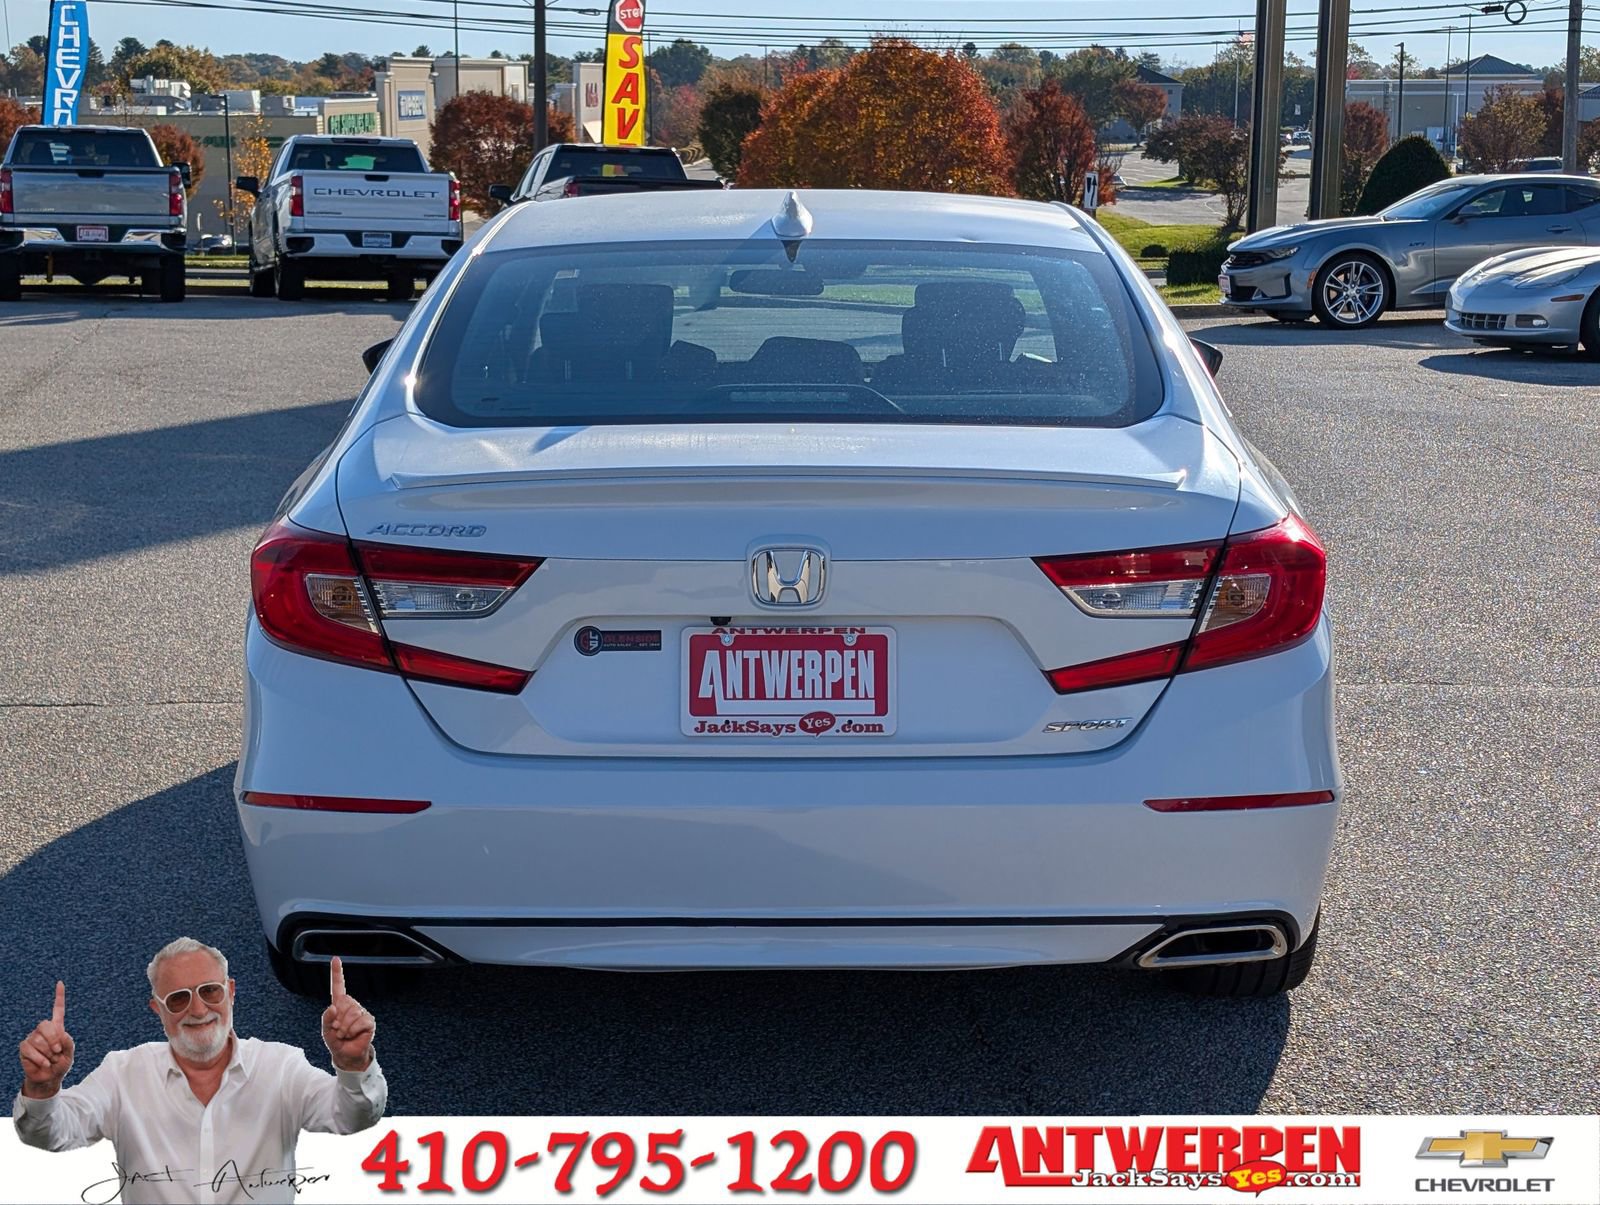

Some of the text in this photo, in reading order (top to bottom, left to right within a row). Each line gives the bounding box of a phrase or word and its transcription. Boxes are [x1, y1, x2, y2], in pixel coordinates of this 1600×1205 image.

[620, 8, 640, 19] STO
[611, 36, 642, 146] SAV
[314, 187, 440, 198] CHEVROLET
[366, 522, 488, 537] ACCORD
[698, 650, 875, 699] ANTWERPEN
[804, 716, 831, 730] Yes
[1042, 717, 1133, 733] SPORT
